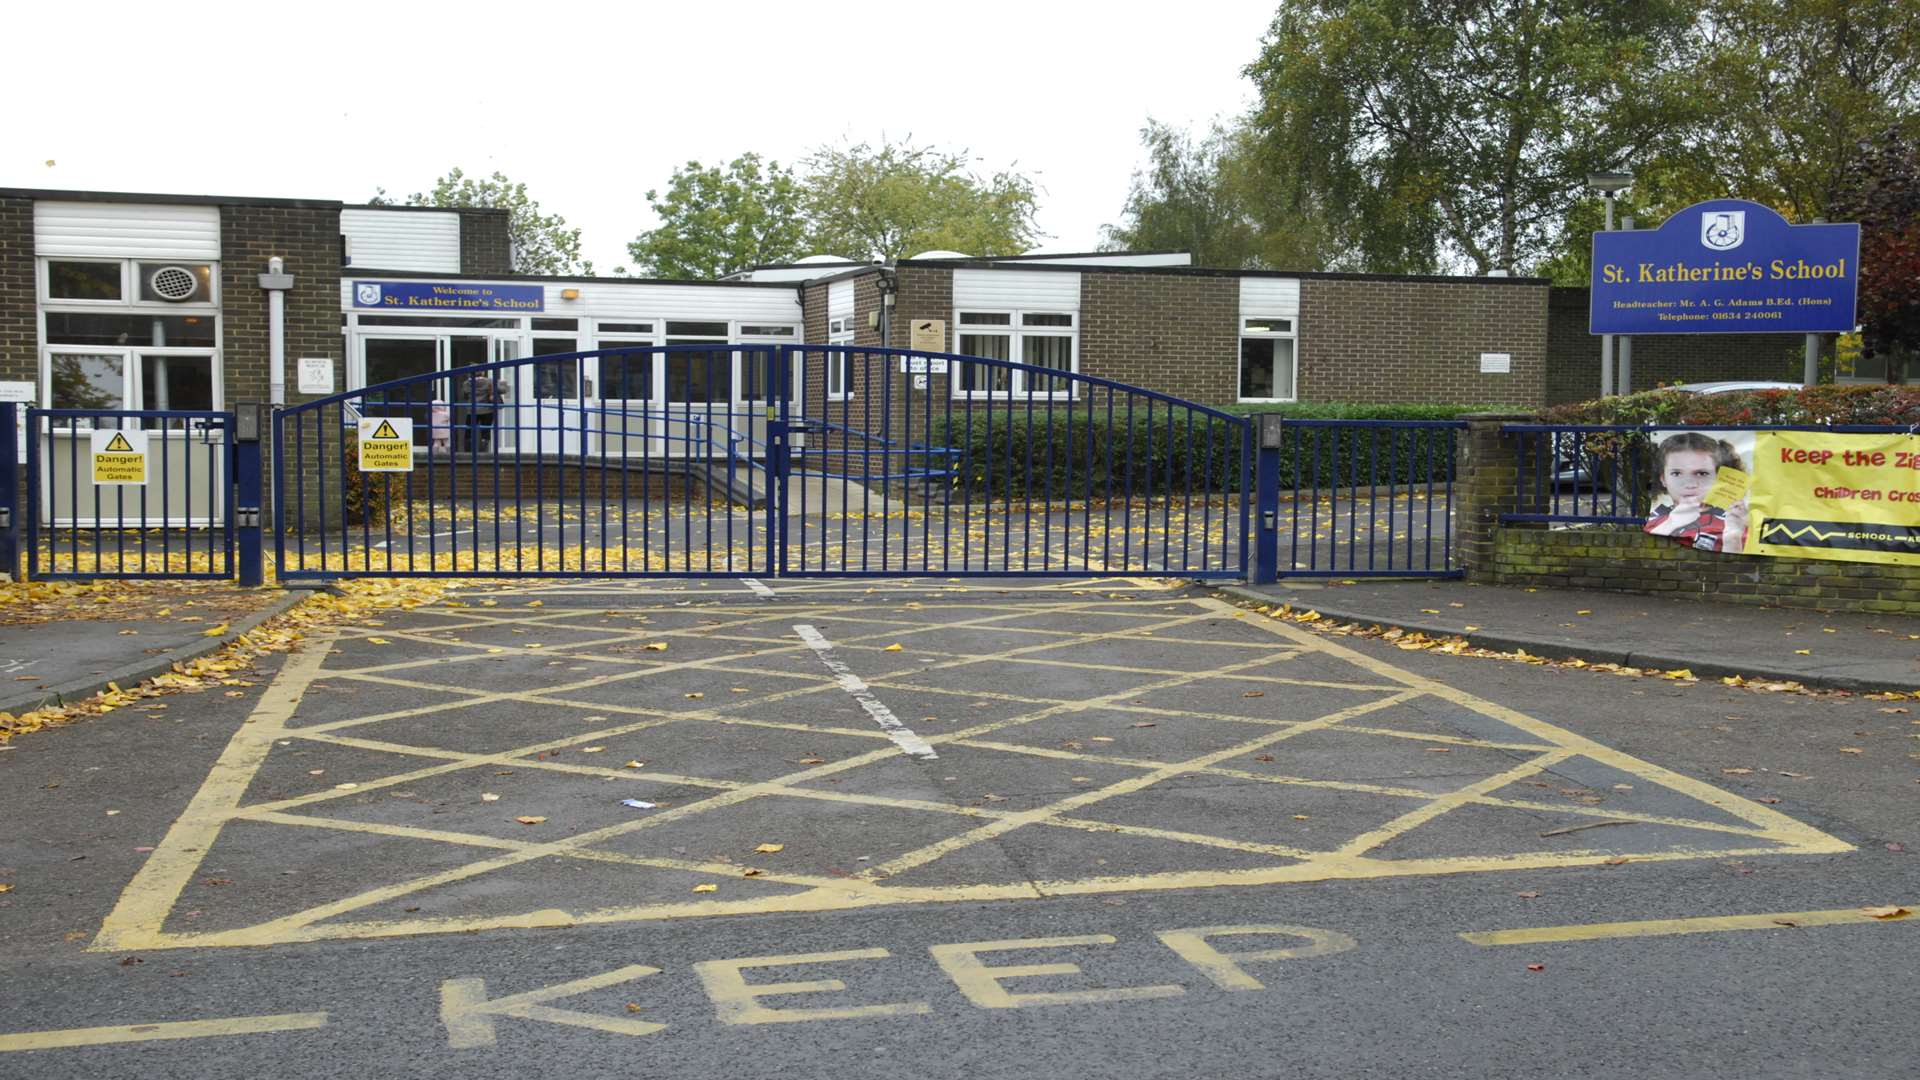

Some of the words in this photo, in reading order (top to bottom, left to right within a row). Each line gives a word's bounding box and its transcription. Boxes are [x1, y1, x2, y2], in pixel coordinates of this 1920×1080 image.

[1602, 264, 1630, 284] St.
[1638, 262, 1763, 283] Katherine's
[1770, 258, 1845, 280] School
[432, 286, 479, 295] Welcome
[482, 287, 493, 295] to
[384, 295, 404, 305] St.
[408, 296, 489, 307] Katherine's
[494, 298, 539, 308] School
[1613, 300, 1677, 309] Headteacher:
[1700, 299, 1711, 307] A.
[1713, 299, 1724, 307] G.
[1728, 299, 1763, 307] Adams
[1766, 298, 1794, 306] B.Ed.
[1798, 297, 1832, 306] (Hons)
[1658, 312, 1710, 321] Telephone:
[1712, 312, 1741, 320] 01634
[1744, 311, 1782, 320] 240061
[364, 442, 408, 452] Danger!
[96, 455, 143, 464] Danger!
[1842, 450, 1886, 467] the
[1848, 532, 1893, 541] SCHOOL
[438, 924, 1358, 1049] KEEP
